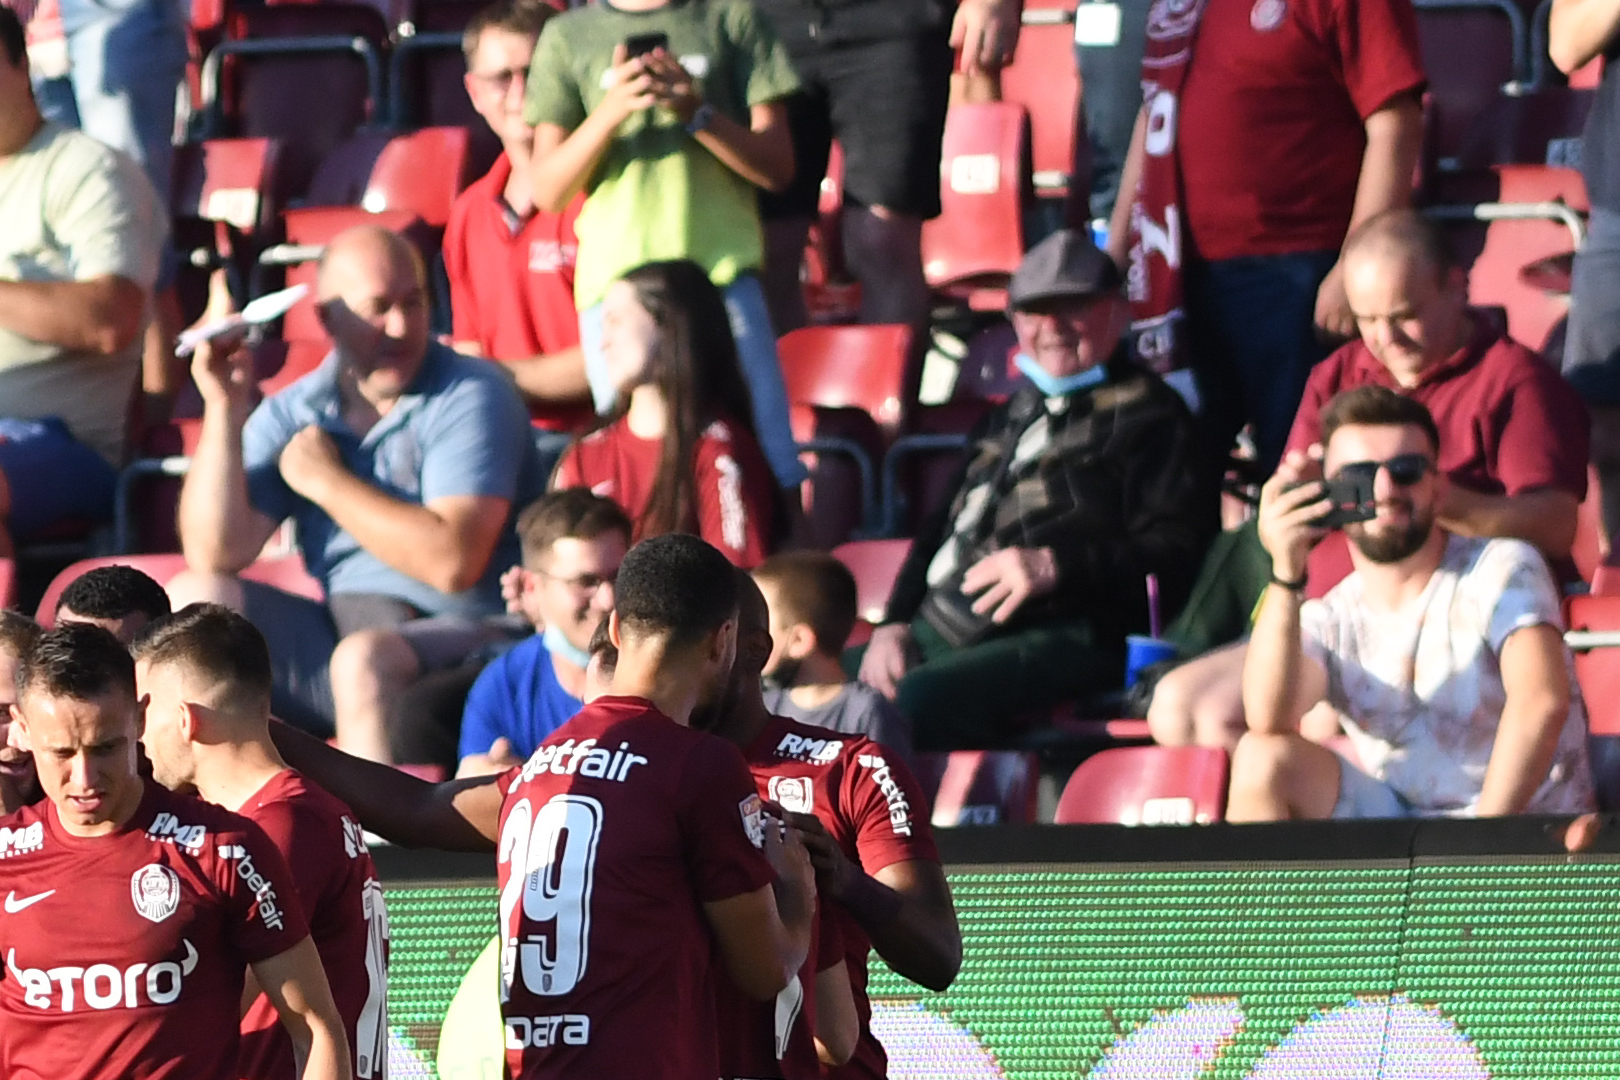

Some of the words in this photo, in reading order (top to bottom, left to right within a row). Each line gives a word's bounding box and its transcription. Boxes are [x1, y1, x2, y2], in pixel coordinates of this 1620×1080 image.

[522, 740, 648, 783] betfair
[777, 733, 844, 760] RMB
[872, 766, 913, 837] betfair
[148, 812, 207, 848] RMB
[237, 854, 284, 931] betfair
